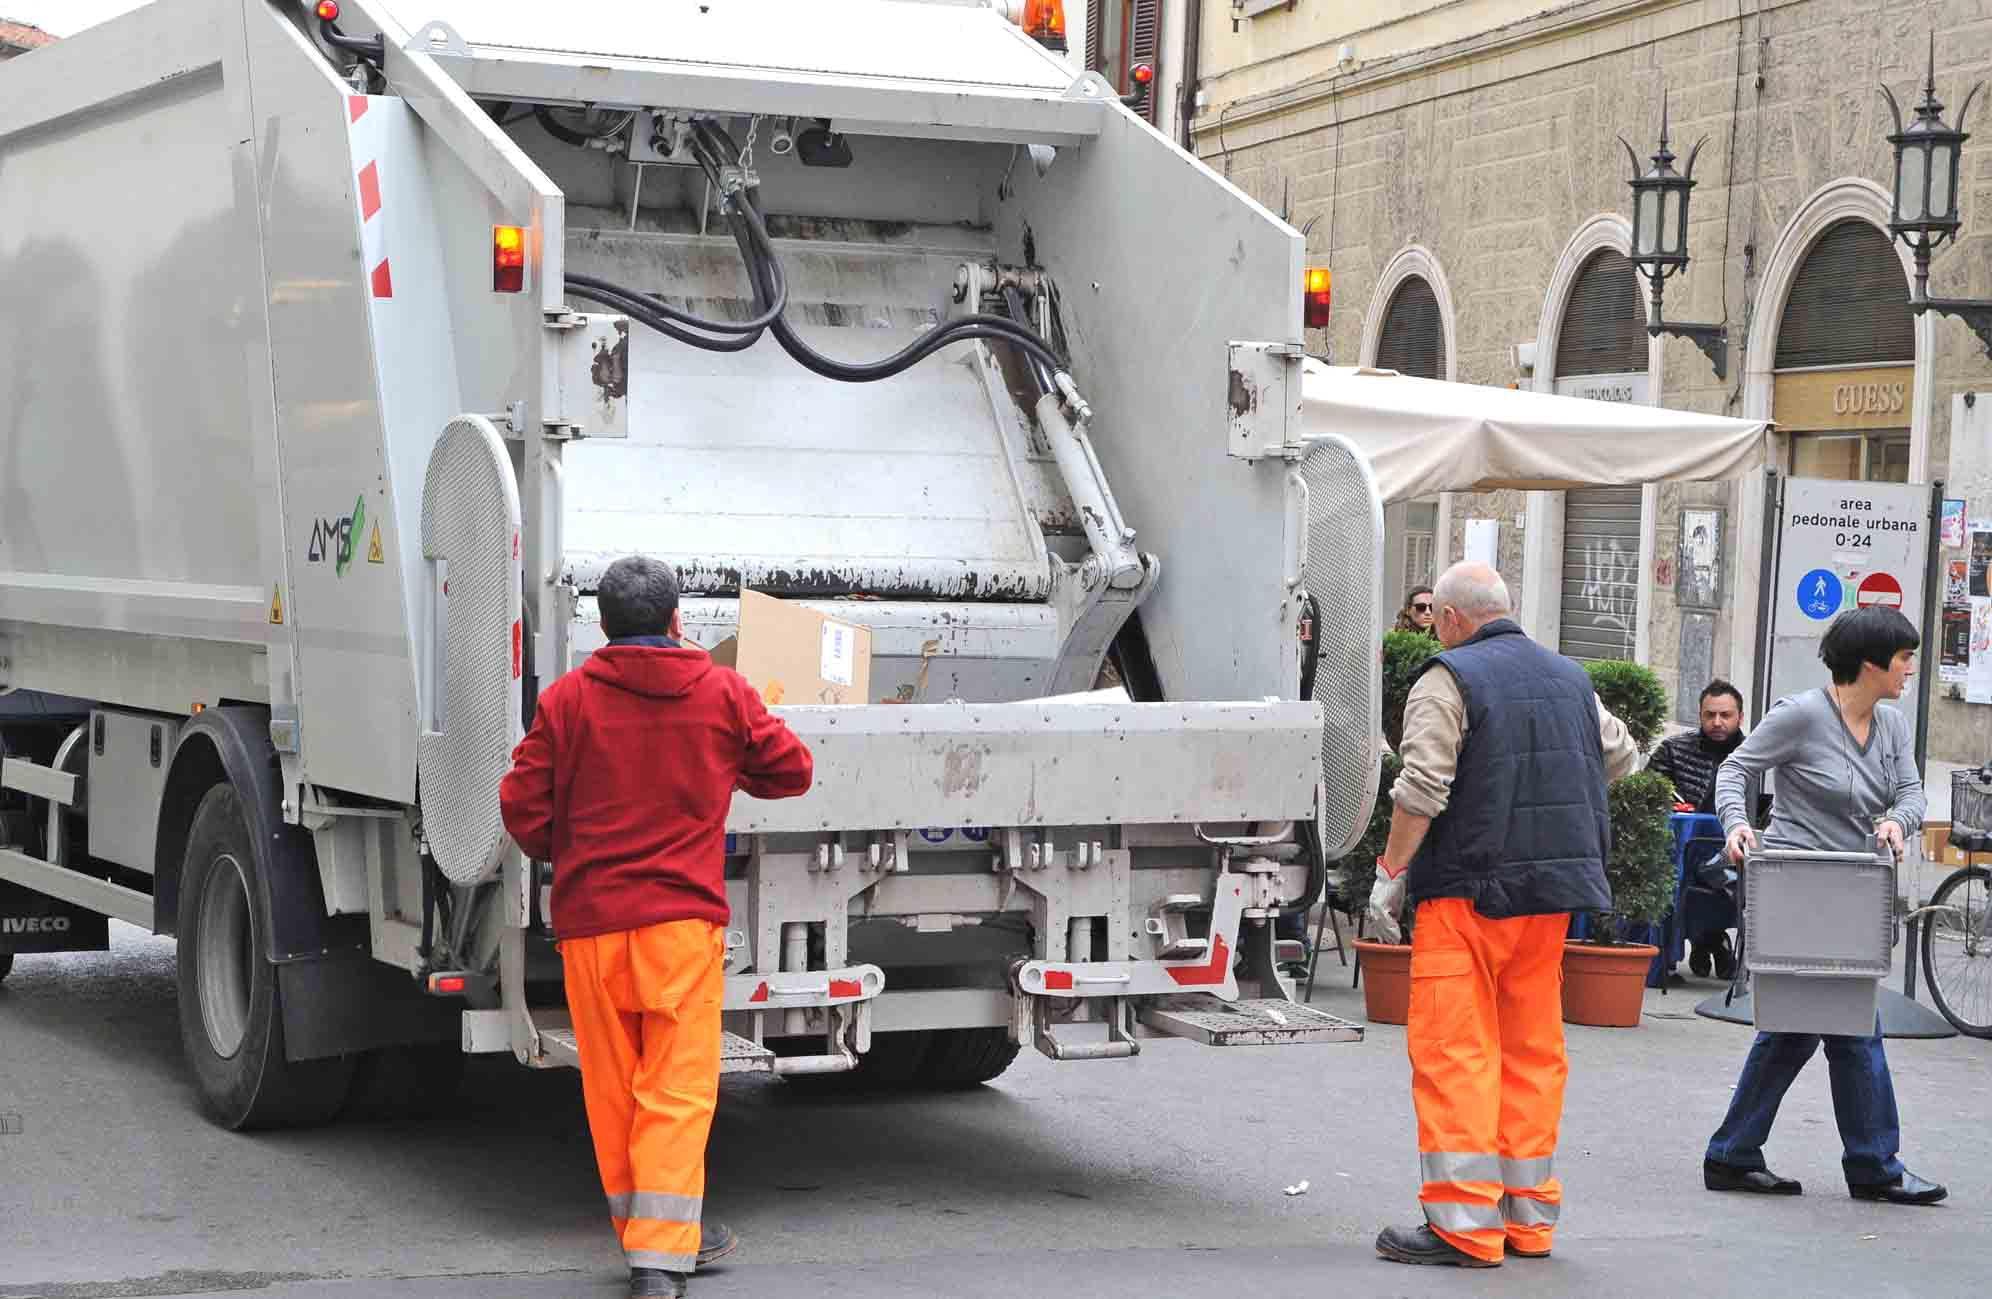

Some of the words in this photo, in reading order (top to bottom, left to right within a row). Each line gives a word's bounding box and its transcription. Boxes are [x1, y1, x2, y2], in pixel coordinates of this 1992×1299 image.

[1833, 384, 1904, 415] GUESS
[1840, 500, 1872, 511] area
[1792, 512, 1861, 529] pedonale
[1866, 517, 1918, 532] urbana
[1835, 534, 1872, 548] 0-24
[3, 916, 69, 933] IVECO
